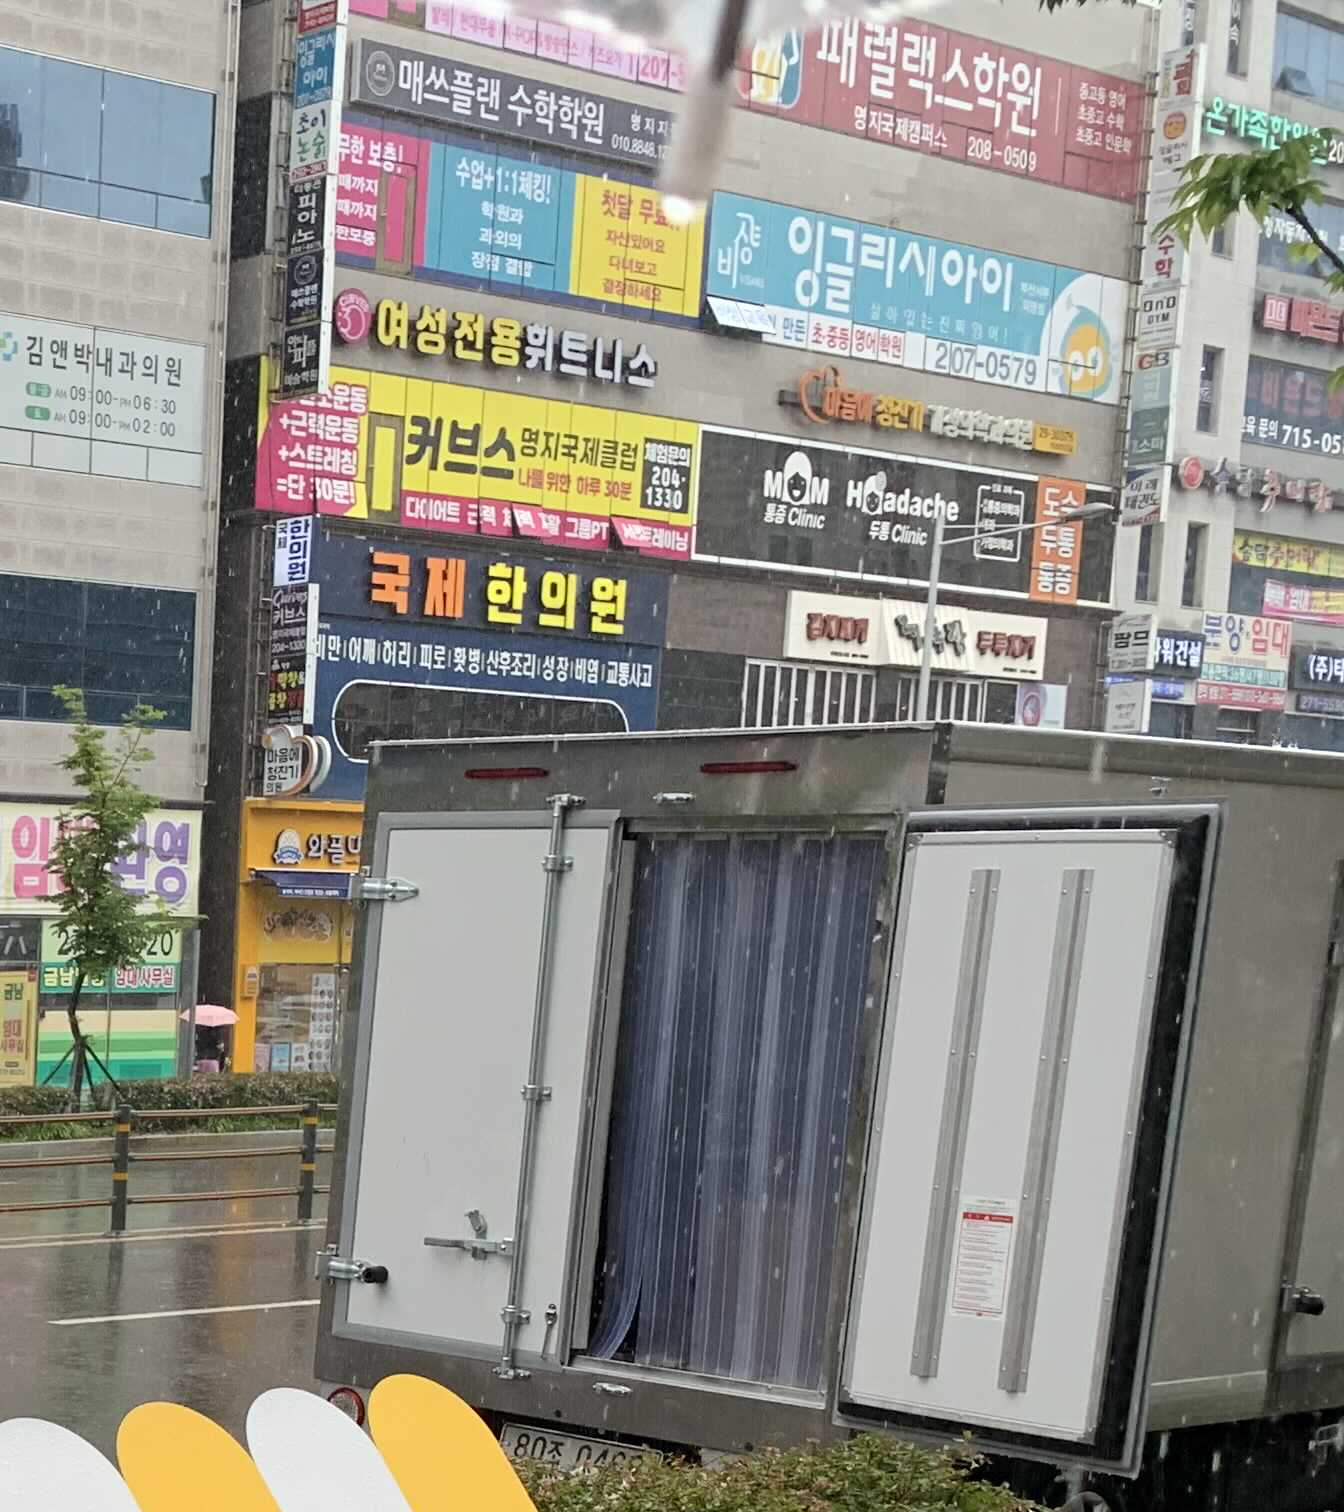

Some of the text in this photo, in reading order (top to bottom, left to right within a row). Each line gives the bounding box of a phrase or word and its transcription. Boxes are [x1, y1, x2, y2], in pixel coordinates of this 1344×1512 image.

[398, 59, 605, 145] 매쓰플랜 수학학원
[853, 104, 1038, 172] 명지국제캠퍼스 208-0509
[26, 335, 183, 388] 김앤박내과의원
[935, 342, 1038, 387] 207-0579
[405, 415, 640, 480] 커브스 명지국제클럽
[644, 486, 684, 511] 1330
[787, 504, 825, 530] Clinic
[891, 524, 928, 547] Clinic
[370, 549, 628, 636] 국제 한의원
[347, 636, 376, 666] 어깨
[381, 639, 411, 668] 허리
[419, 643, 446, 670] 피로
[485, 649, 537, 679] 산후조리
[605, 660, 653, 689] 교통사고
